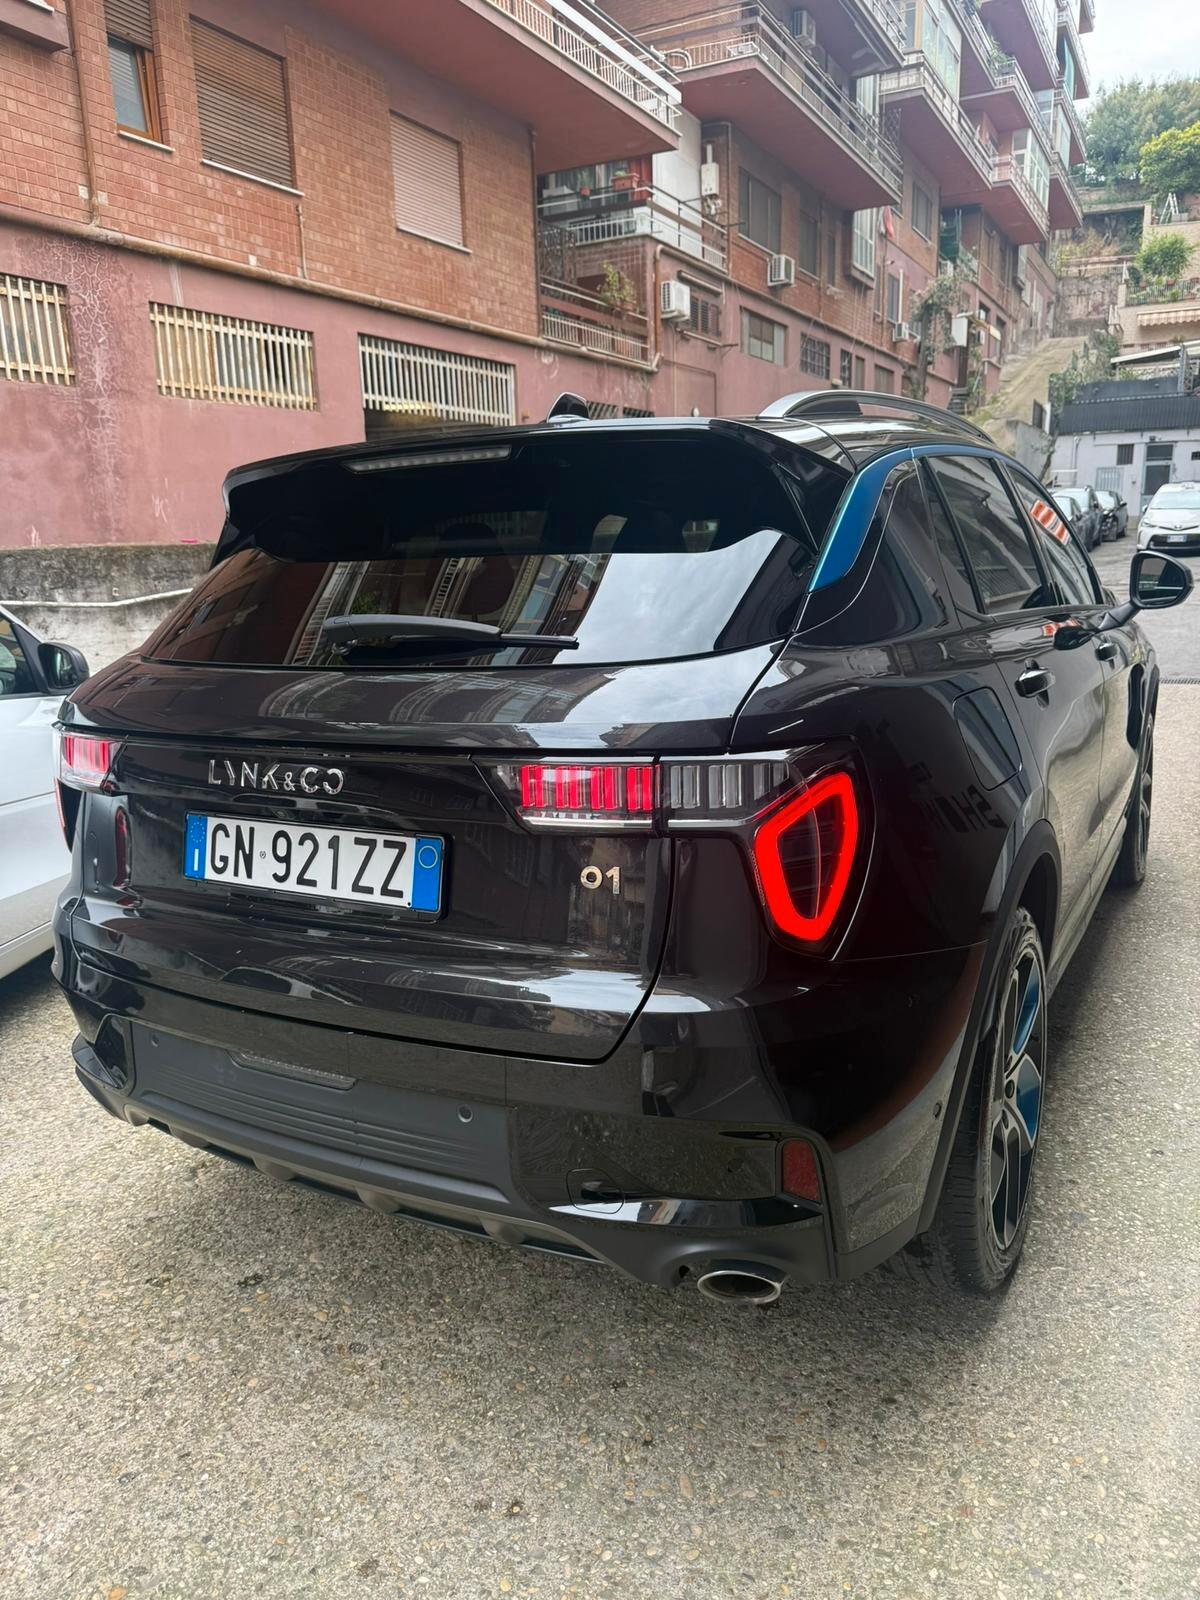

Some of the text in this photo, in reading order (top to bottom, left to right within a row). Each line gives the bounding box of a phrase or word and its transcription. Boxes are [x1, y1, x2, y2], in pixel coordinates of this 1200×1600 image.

[208, 758, 345, 795] LYNK&CO
[210, 823, 407, 898] GN 921ZZ
[579, 865, 622, 895] 01
